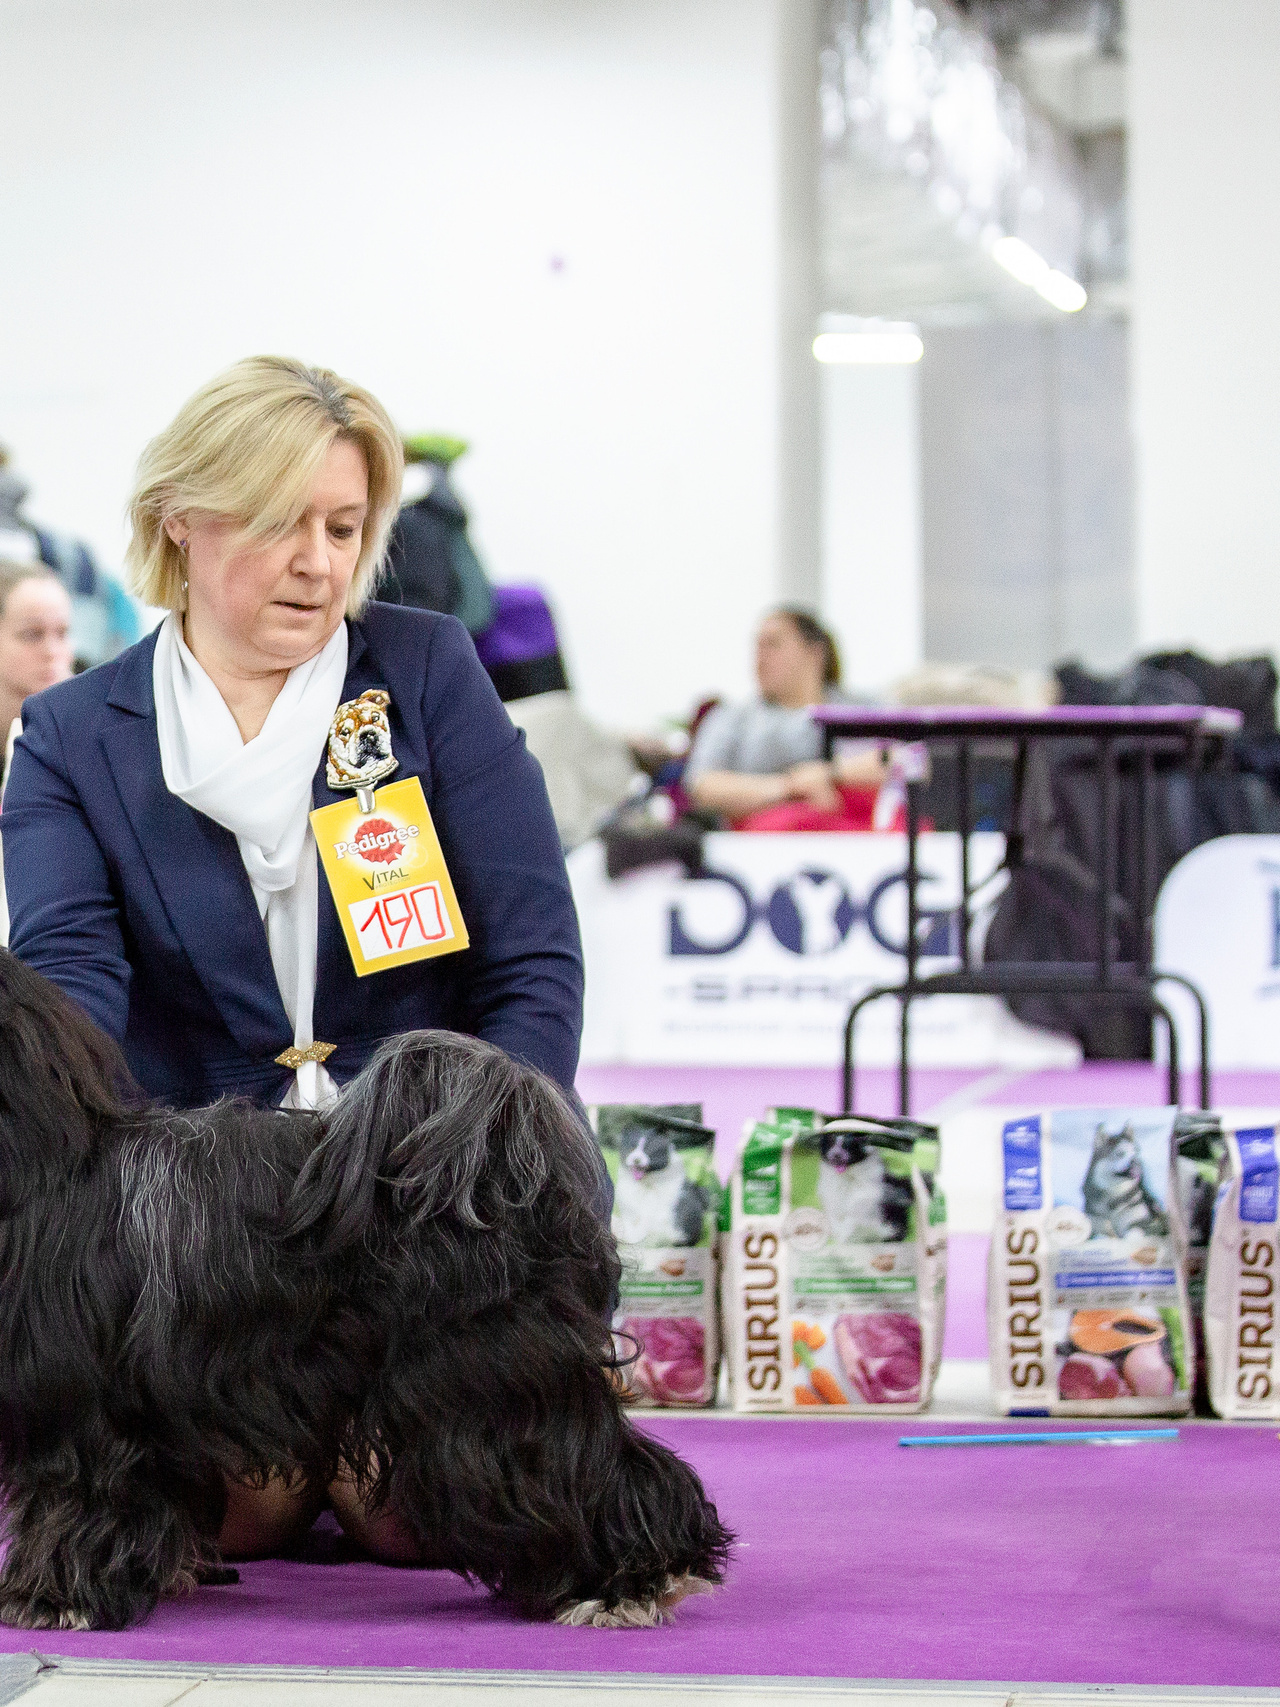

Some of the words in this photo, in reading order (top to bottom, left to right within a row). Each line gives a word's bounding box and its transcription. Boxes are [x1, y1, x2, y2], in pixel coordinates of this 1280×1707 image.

[333, 825, 420, 859] Pedigree
[362, 867, 409, 890] VITAL
[360, 886, 446, 949] 190
[744, 1231, 782, 1391] SIRIUS
[1004, 1227, 1045, 1388] SIRIUS
[1237, 1239, 1274, 1399] SIRIUS
